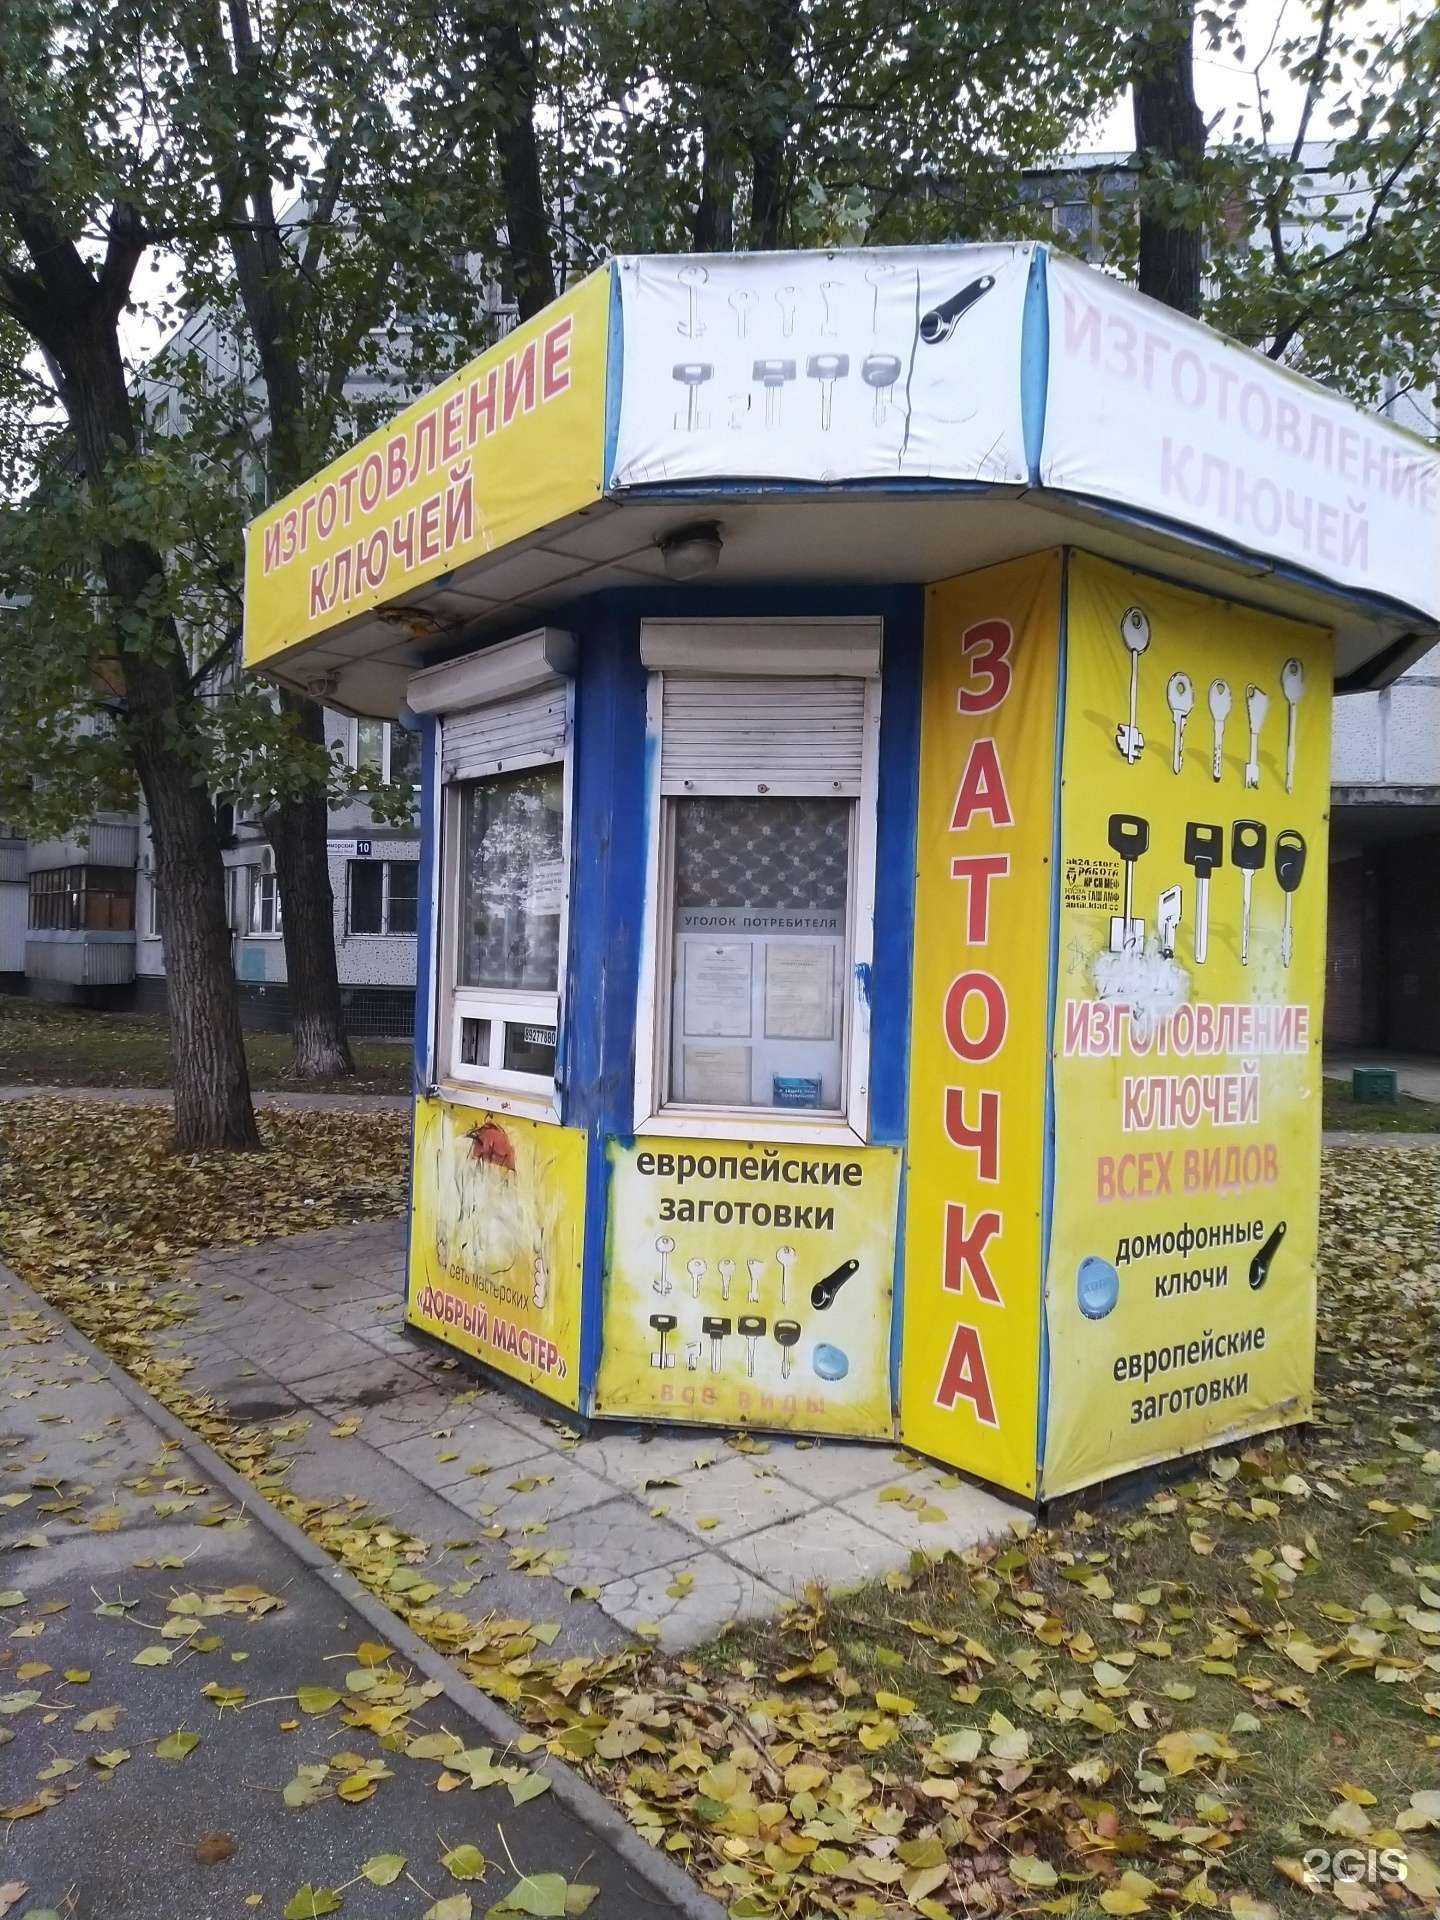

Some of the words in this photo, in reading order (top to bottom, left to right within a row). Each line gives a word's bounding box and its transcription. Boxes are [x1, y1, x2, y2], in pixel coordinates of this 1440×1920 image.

[263, 313, 574, 575] ИЗГОТОВЛЕНИЕ
[1160, 436, 1370, 572] КЛЮЧЕЙ
[308, 456, 474, 620] КЛЮЧЕЙ
[358, 842, 369, 853] 10
[684, 915, 736, 927] УГОЛОК
[743, 917, 838, 929] ПОТРЕБИТЕЛЯ
[933, 617, 1017, 1430] ЗАТОЧКА
[1122, 1060, 1261, 1131] КЛЮЧЕЙ
[636, 1149, 863, 1187] европейские
[1097, 1150, 1174, 1203] ВСЕХ
[1183, 1144, 1280, 1199] ВИДОВ
[659, 1197, 835, 1231] заготовки
[1115, 1219, 1264, 1266] домофонные
[449, 1263, 470, 1285] сеть
[472, 1273, 530, 1312] мастерских
[1155, 1265, 1229, 1298] ключи
[416, 1285, 488, 1342] «ДОБРЫЙ
[492, 1316, 568, 1380] МАСТЕР»
[1113, 1326, 1266, 1382] европейские
[1130, 1372, 1249, 1425] заготовки
